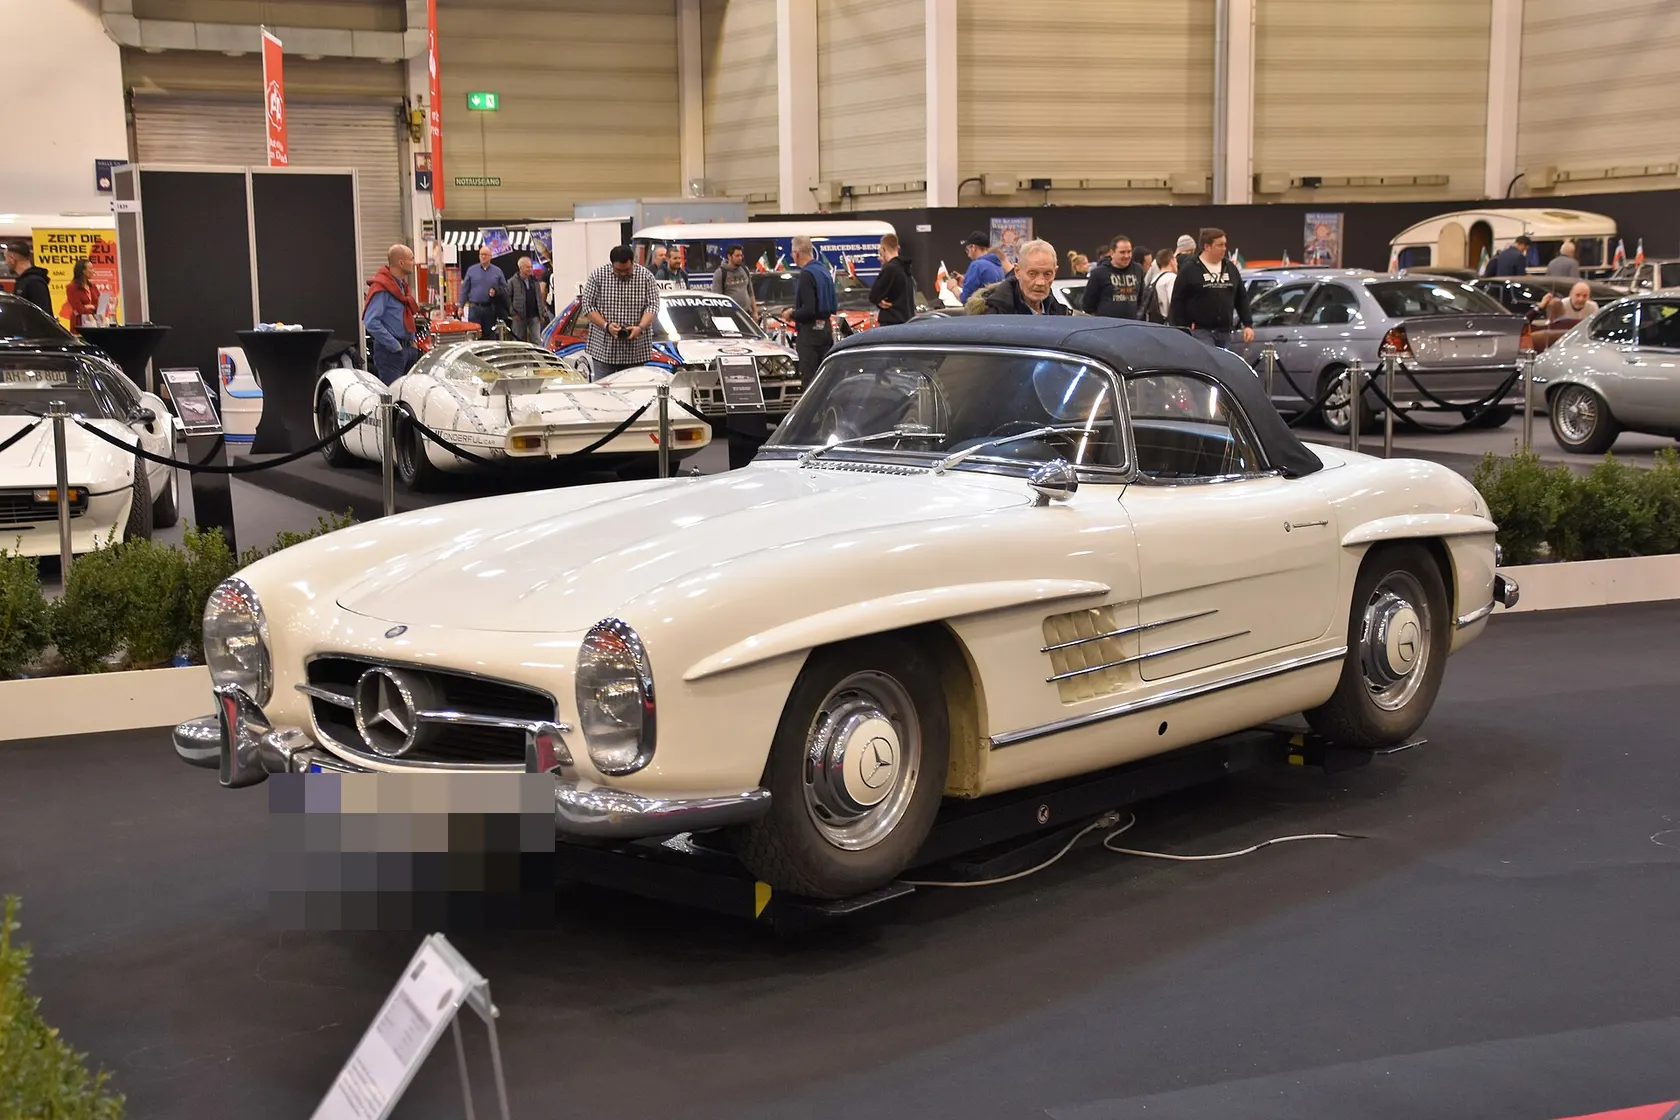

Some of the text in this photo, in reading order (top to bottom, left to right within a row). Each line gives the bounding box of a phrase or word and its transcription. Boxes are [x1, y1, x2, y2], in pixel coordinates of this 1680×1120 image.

[48, 234, 101, 243] ZEIT DIE
[41, 245, 111, 254] FARBE ZU
[666, 298, 733, 307] TINI RACING
